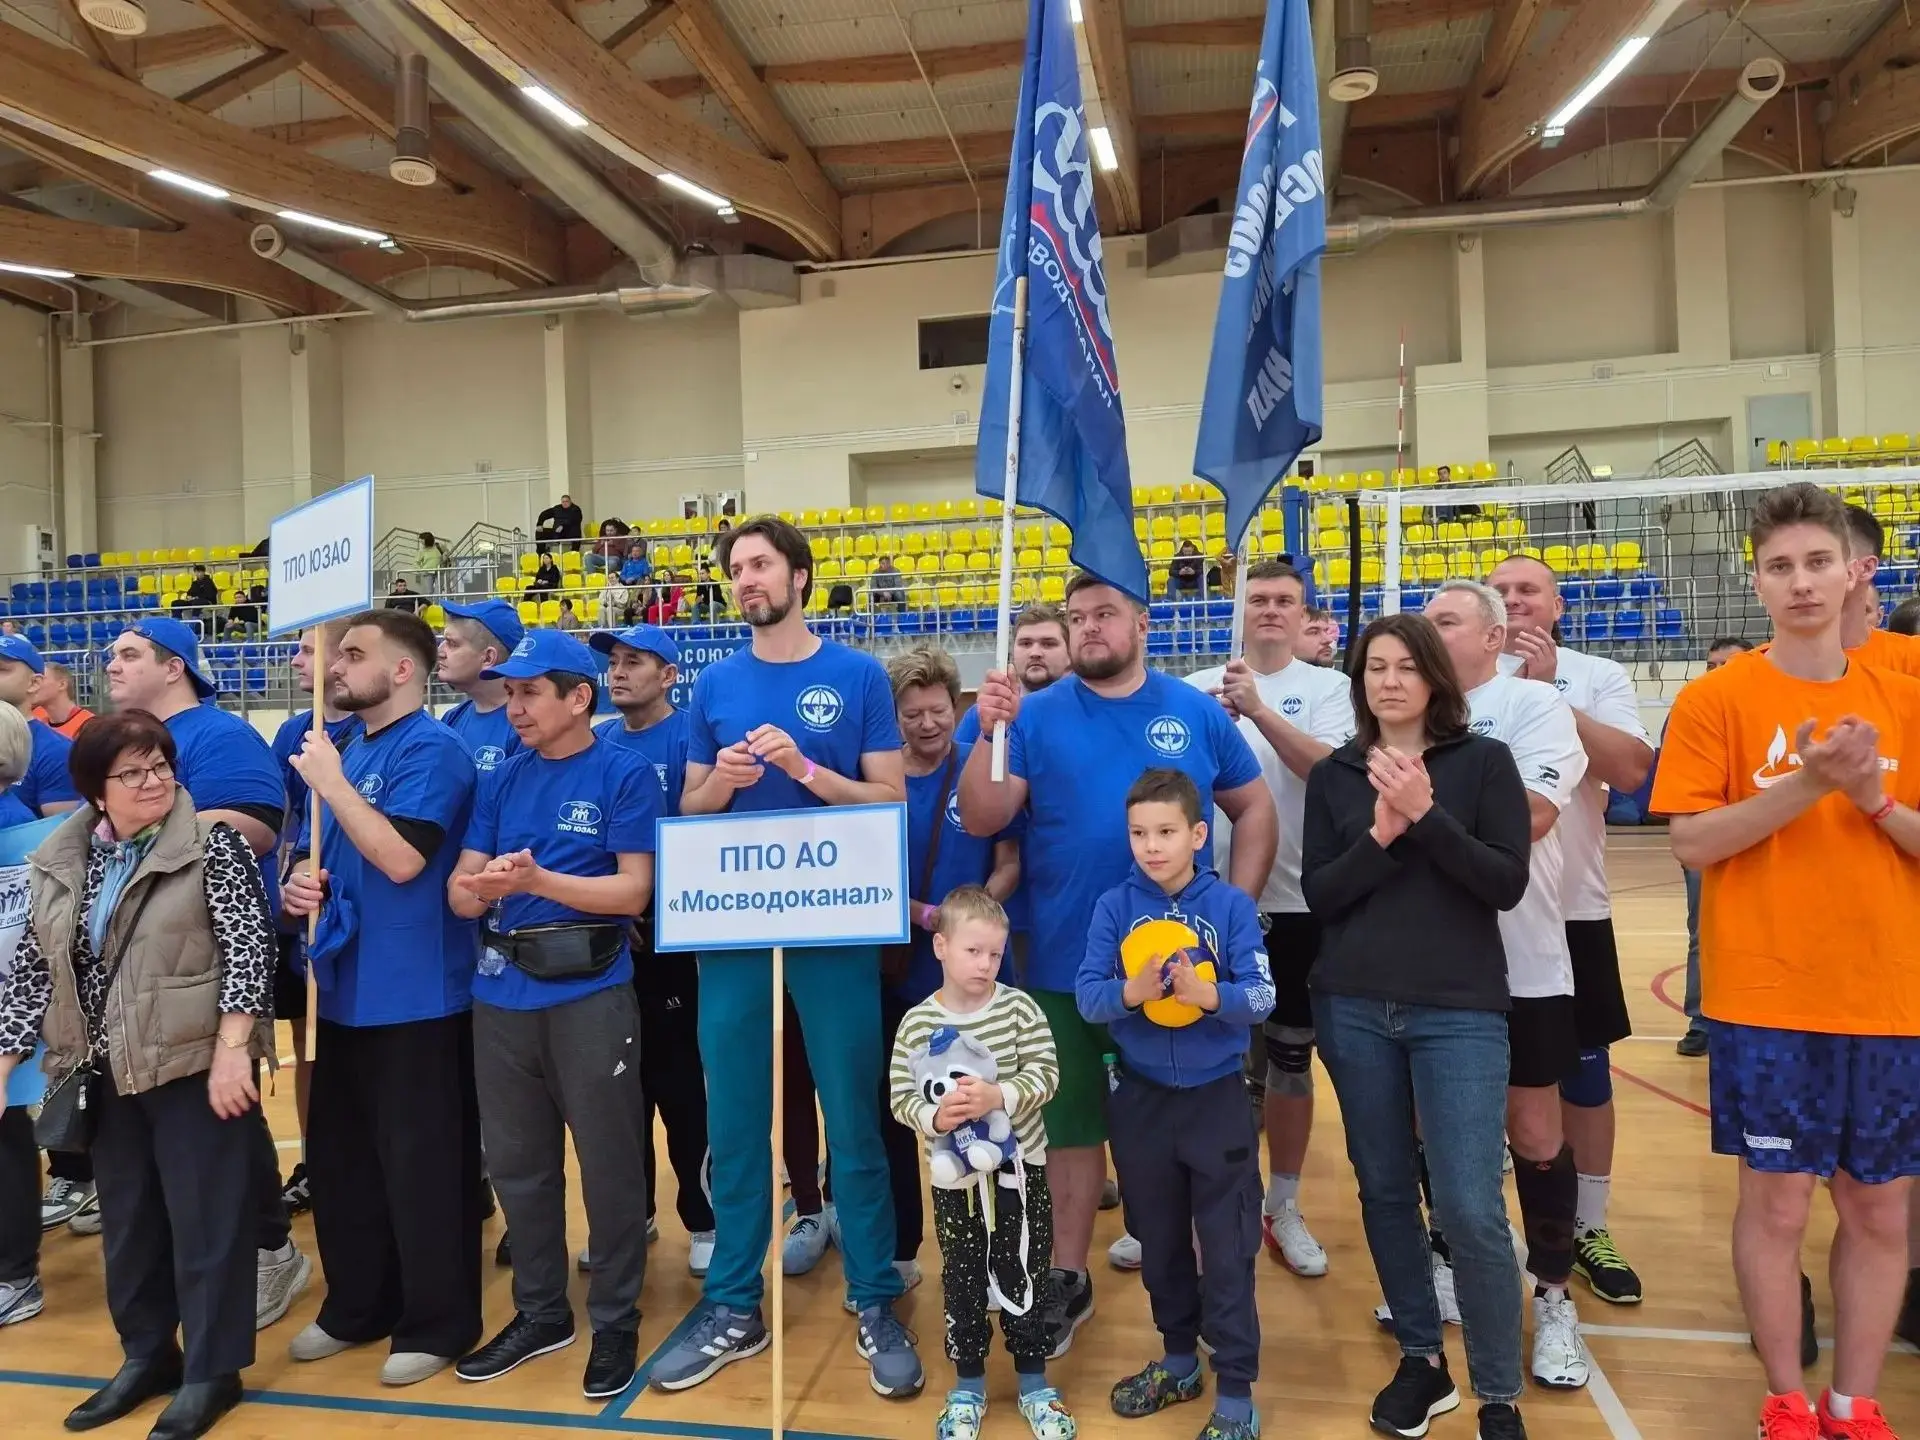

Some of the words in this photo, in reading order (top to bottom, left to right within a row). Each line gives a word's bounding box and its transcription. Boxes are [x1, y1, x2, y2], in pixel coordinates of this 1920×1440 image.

[283, 553, 305, 583] ТПО
[309, 537, 350, 574] ЮЗАО
[678, 648, 734, 664] СОЮЗ
[720, 843, 786, 872] ППО
[795, 840, 838, 869] АО
[668, 886, 893, 914] «Мосводоканал»
